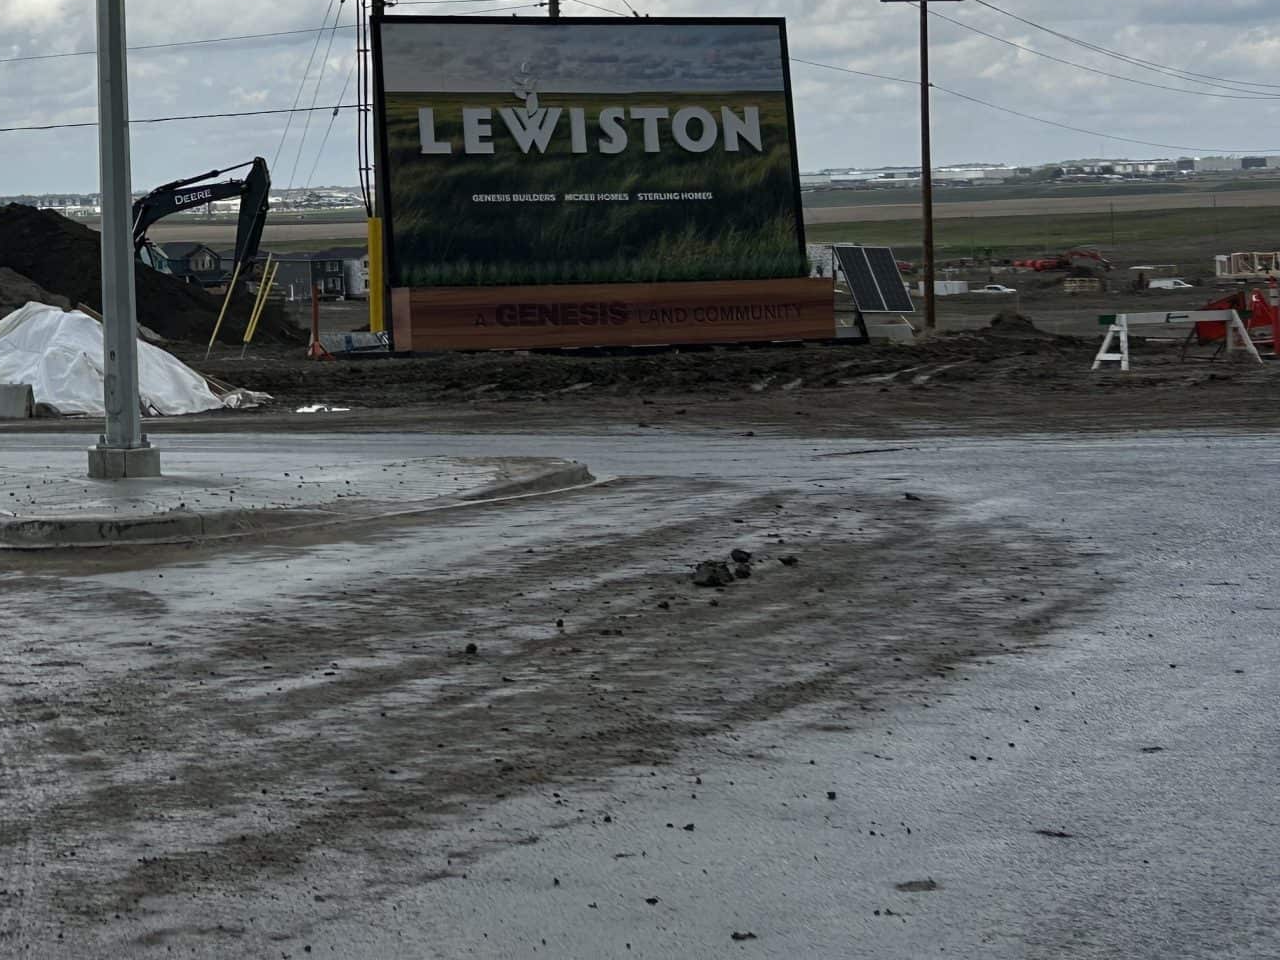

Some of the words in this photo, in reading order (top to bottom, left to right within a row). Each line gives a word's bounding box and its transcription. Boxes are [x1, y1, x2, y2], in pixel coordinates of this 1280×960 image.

[417, 105, 764, 155] LEWISTON
[174, 188, 212, 205] DEERE
[472, 193, 511, 203] GENESIS
[512, 193, 557, 203] BUILDERS
[597, 192, 629, 201] HOMES
[637, 191, 681, 201] STERLING
[681, 191, 713, 200] HOMES
[473, 312, 488, 328] A
[495, 301, 629, 327] GENESIS
[638, 305, 688, 324] LAND
[693, 302, 802, 323] COMMUNITY
